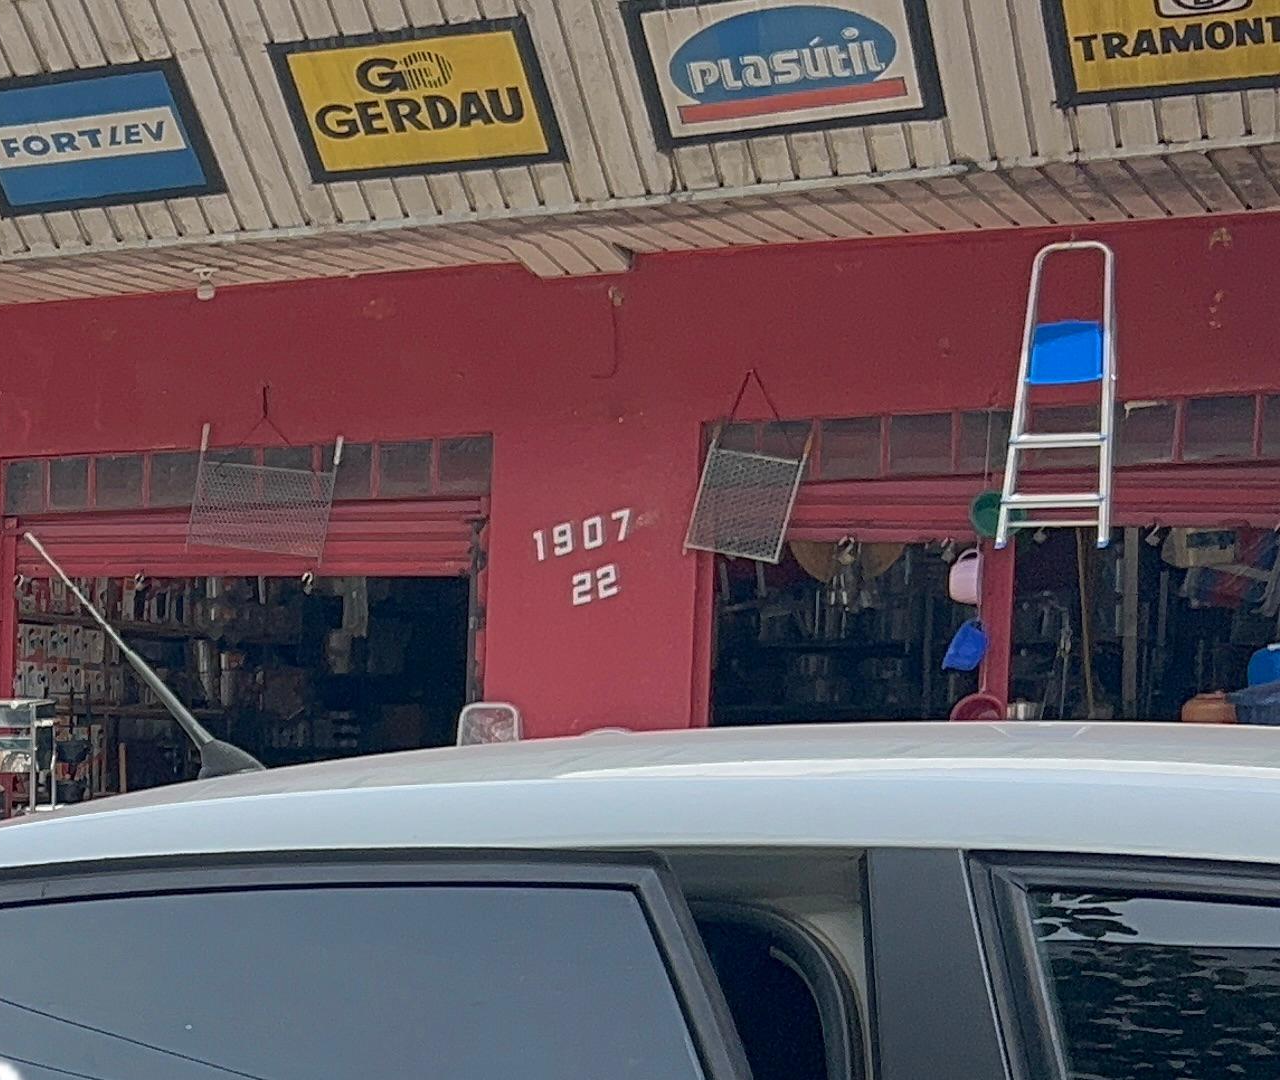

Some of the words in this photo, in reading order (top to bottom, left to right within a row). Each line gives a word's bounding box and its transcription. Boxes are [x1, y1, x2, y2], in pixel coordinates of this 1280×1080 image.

[315, 86, 524, 139] GERDAU
[1, 120, 166, 159] FORTLEV
[533, 508, 631, 561] 1907
[572, 564, 619, 605] 22
